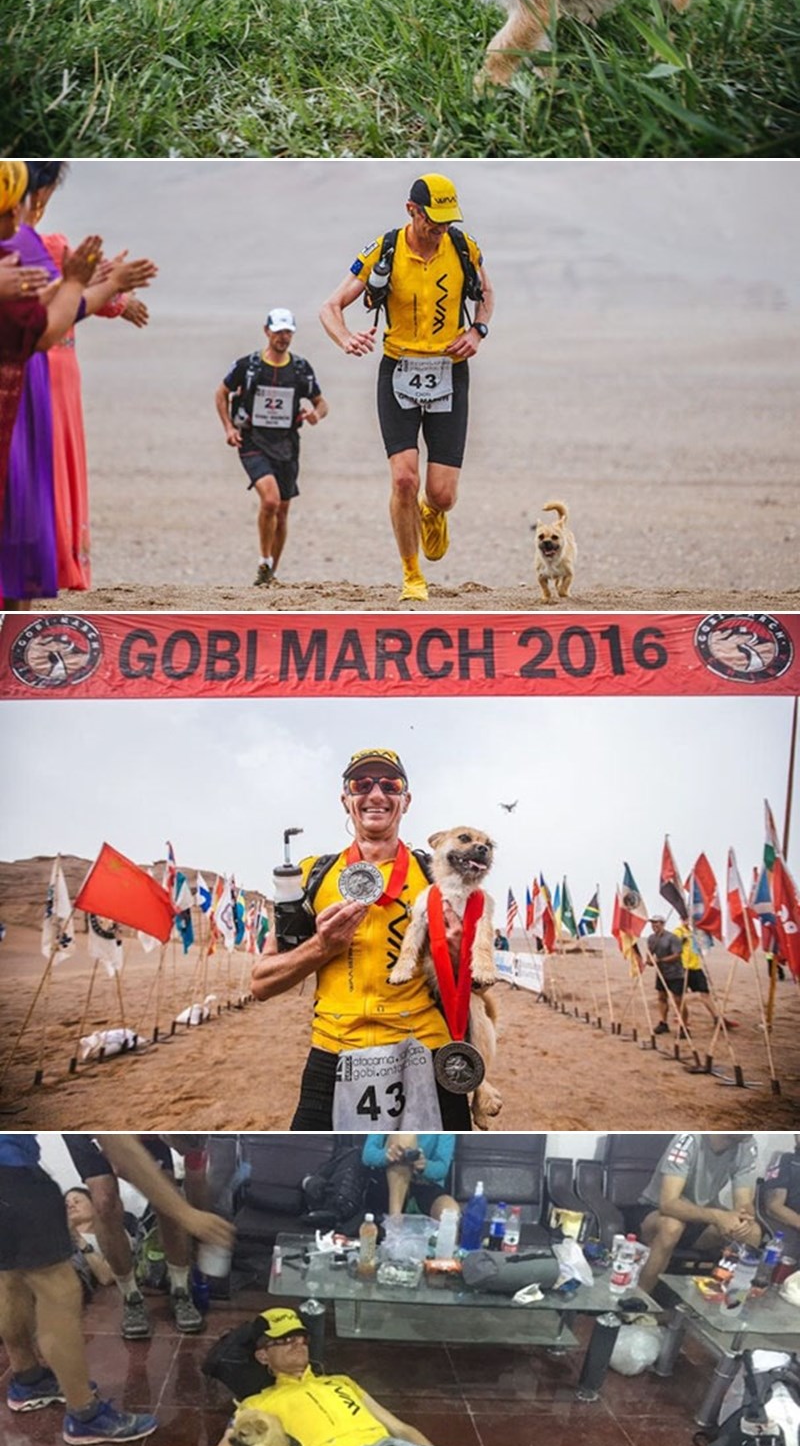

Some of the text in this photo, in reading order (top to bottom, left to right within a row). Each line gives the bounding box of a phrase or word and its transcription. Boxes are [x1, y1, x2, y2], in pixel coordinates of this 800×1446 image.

[409, 374, 437, 389] 43
[265, 397, 283, 409] 22
[118, 624, 668, 682] GOBI MARCH 2016
[356, 1081, 406, 1121] 43
